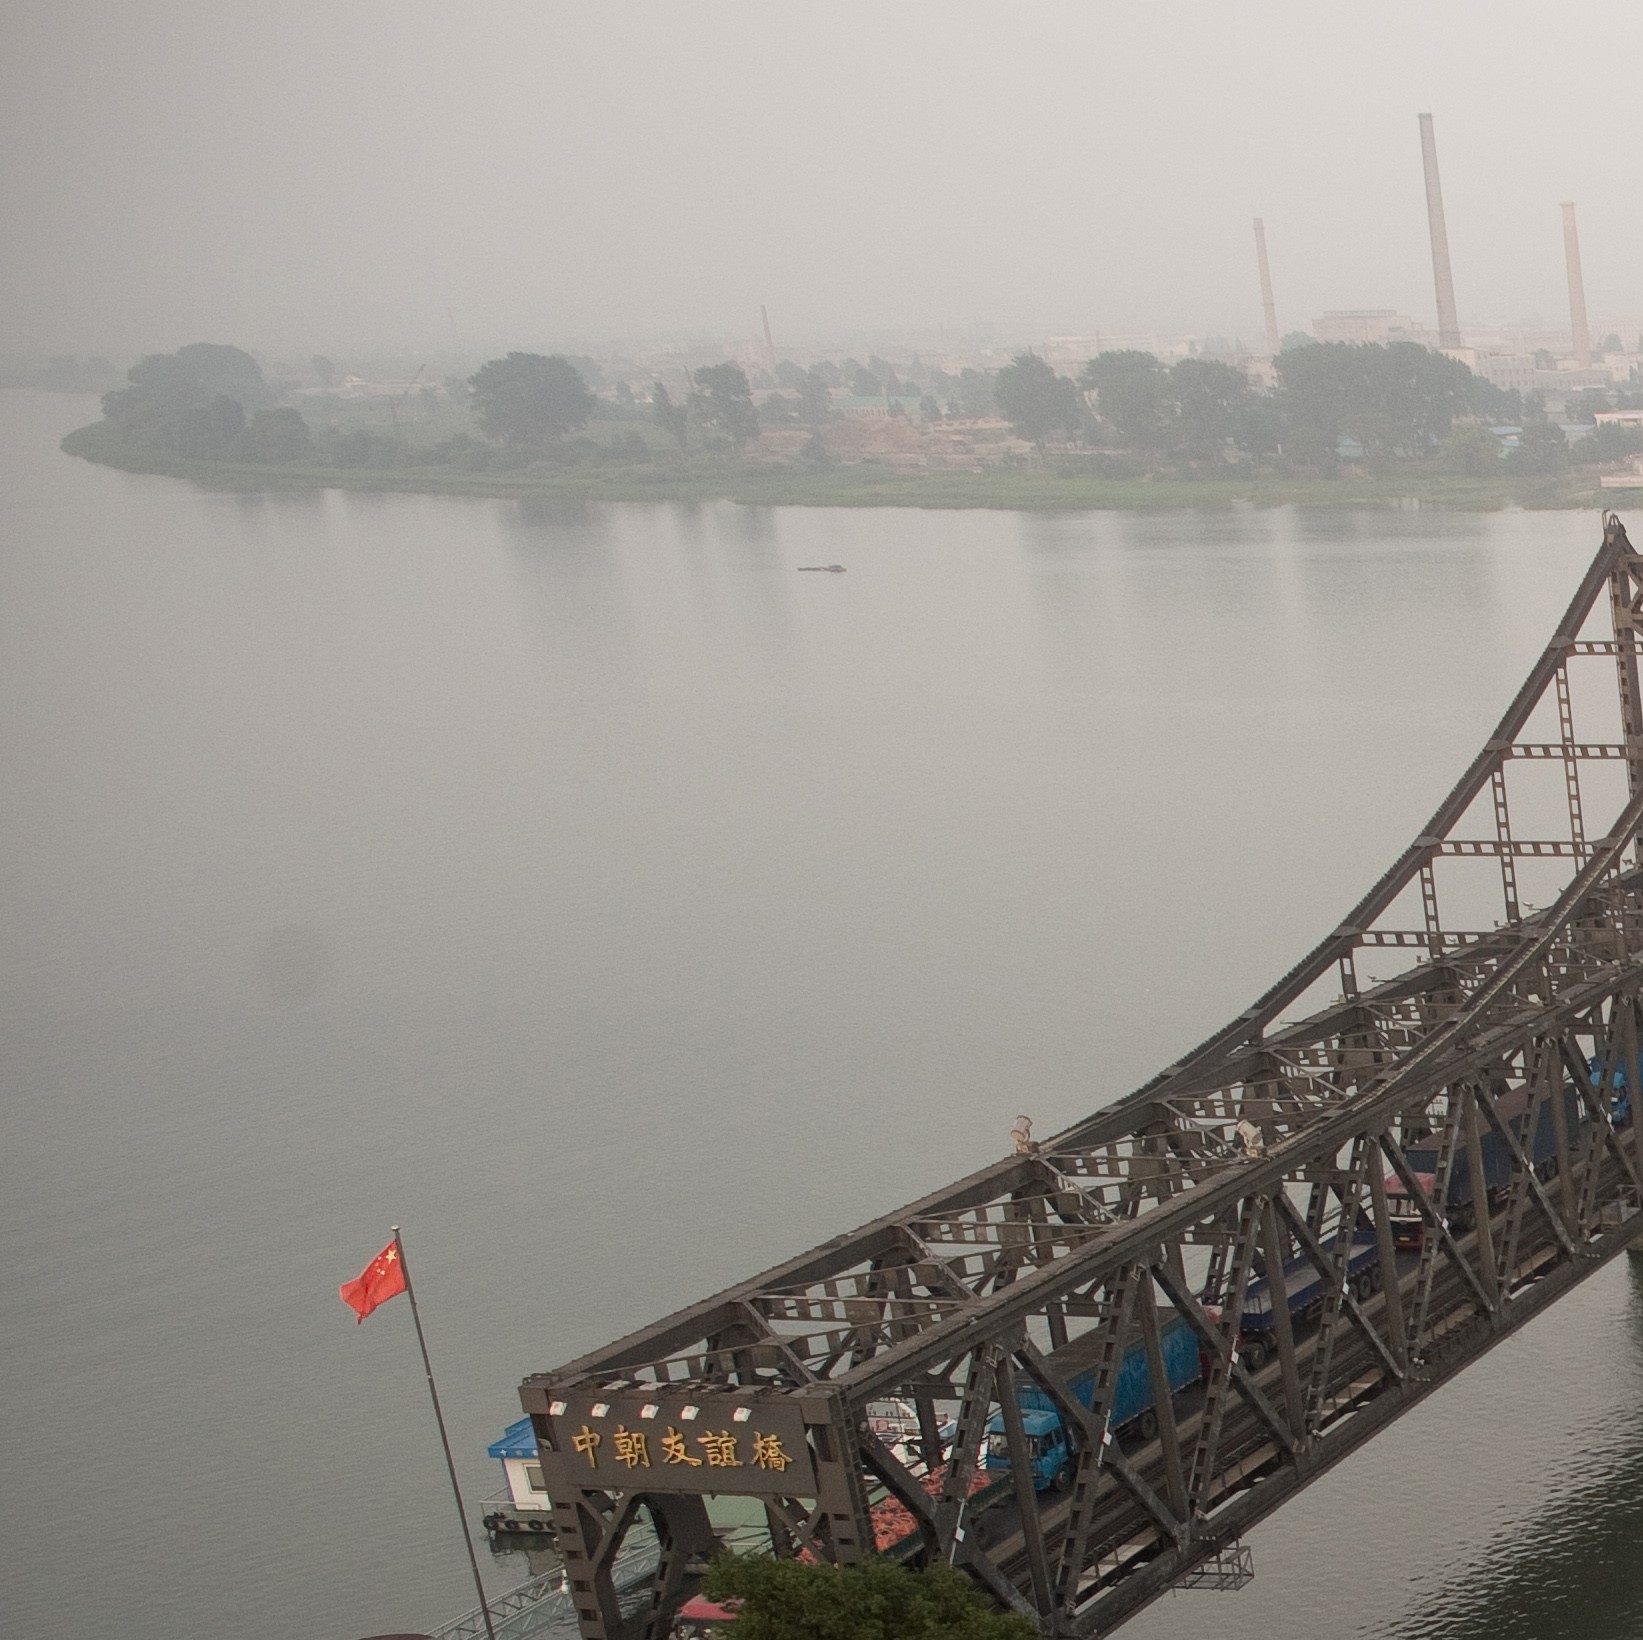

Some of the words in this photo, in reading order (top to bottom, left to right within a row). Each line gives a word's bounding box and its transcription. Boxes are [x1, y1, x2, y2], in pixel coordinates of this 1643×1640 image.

[571, 1424, 793, 1472] 中朝友誼橋
